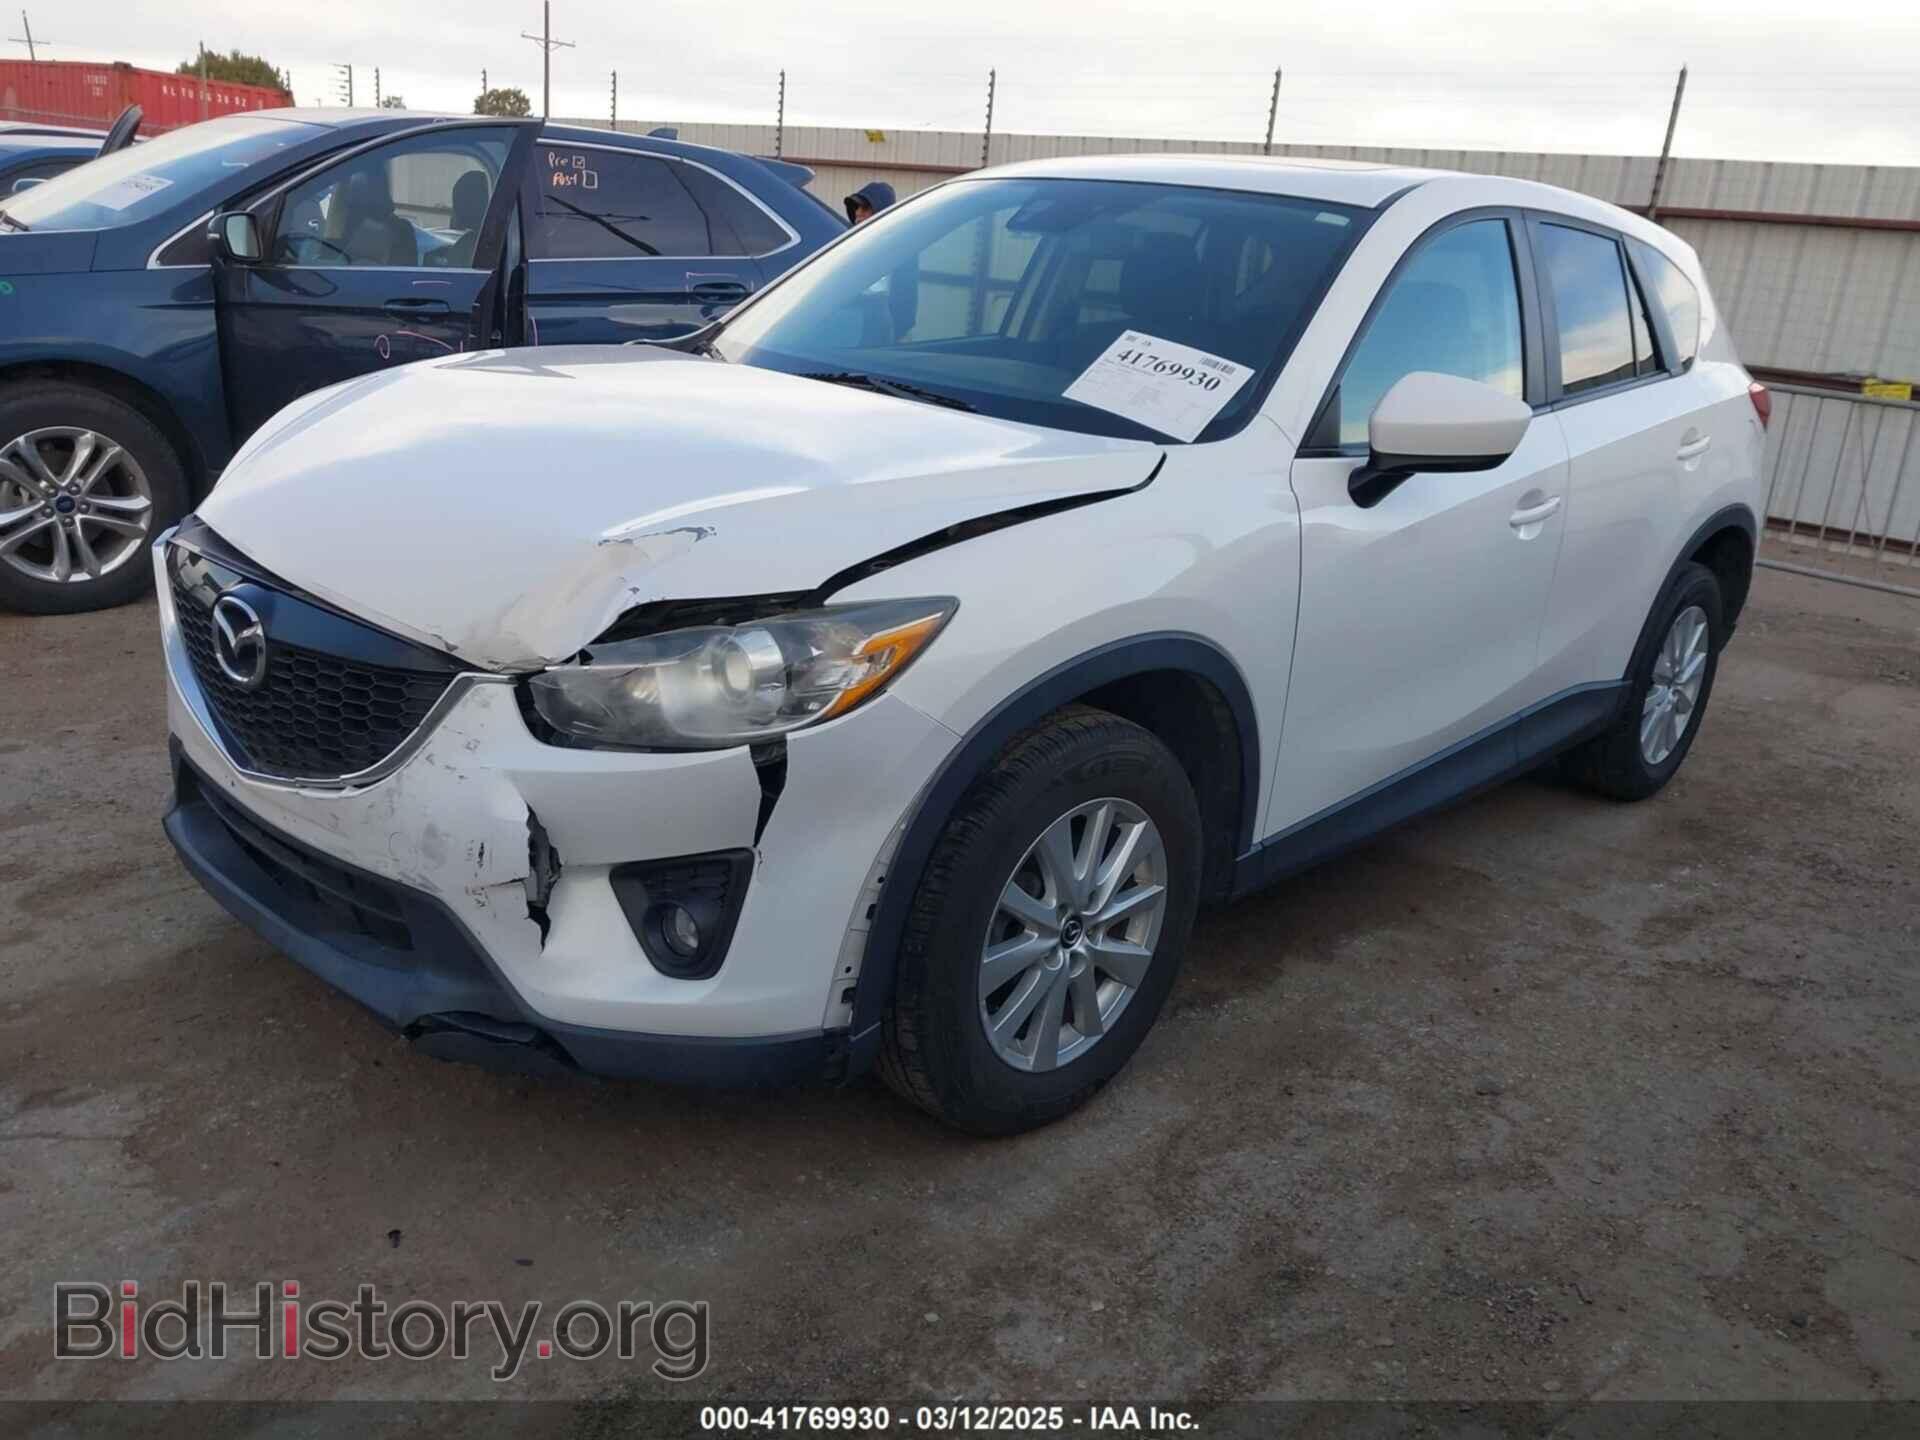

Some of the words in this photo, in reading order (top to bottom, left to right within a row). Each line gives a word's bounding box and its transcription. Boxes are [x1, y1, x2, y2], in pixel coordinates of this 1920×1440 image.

[548, 151, 569, 169] Pre
[552, 171, 578, 187] Post
[1117, 349, 1222, 392] 41769930
